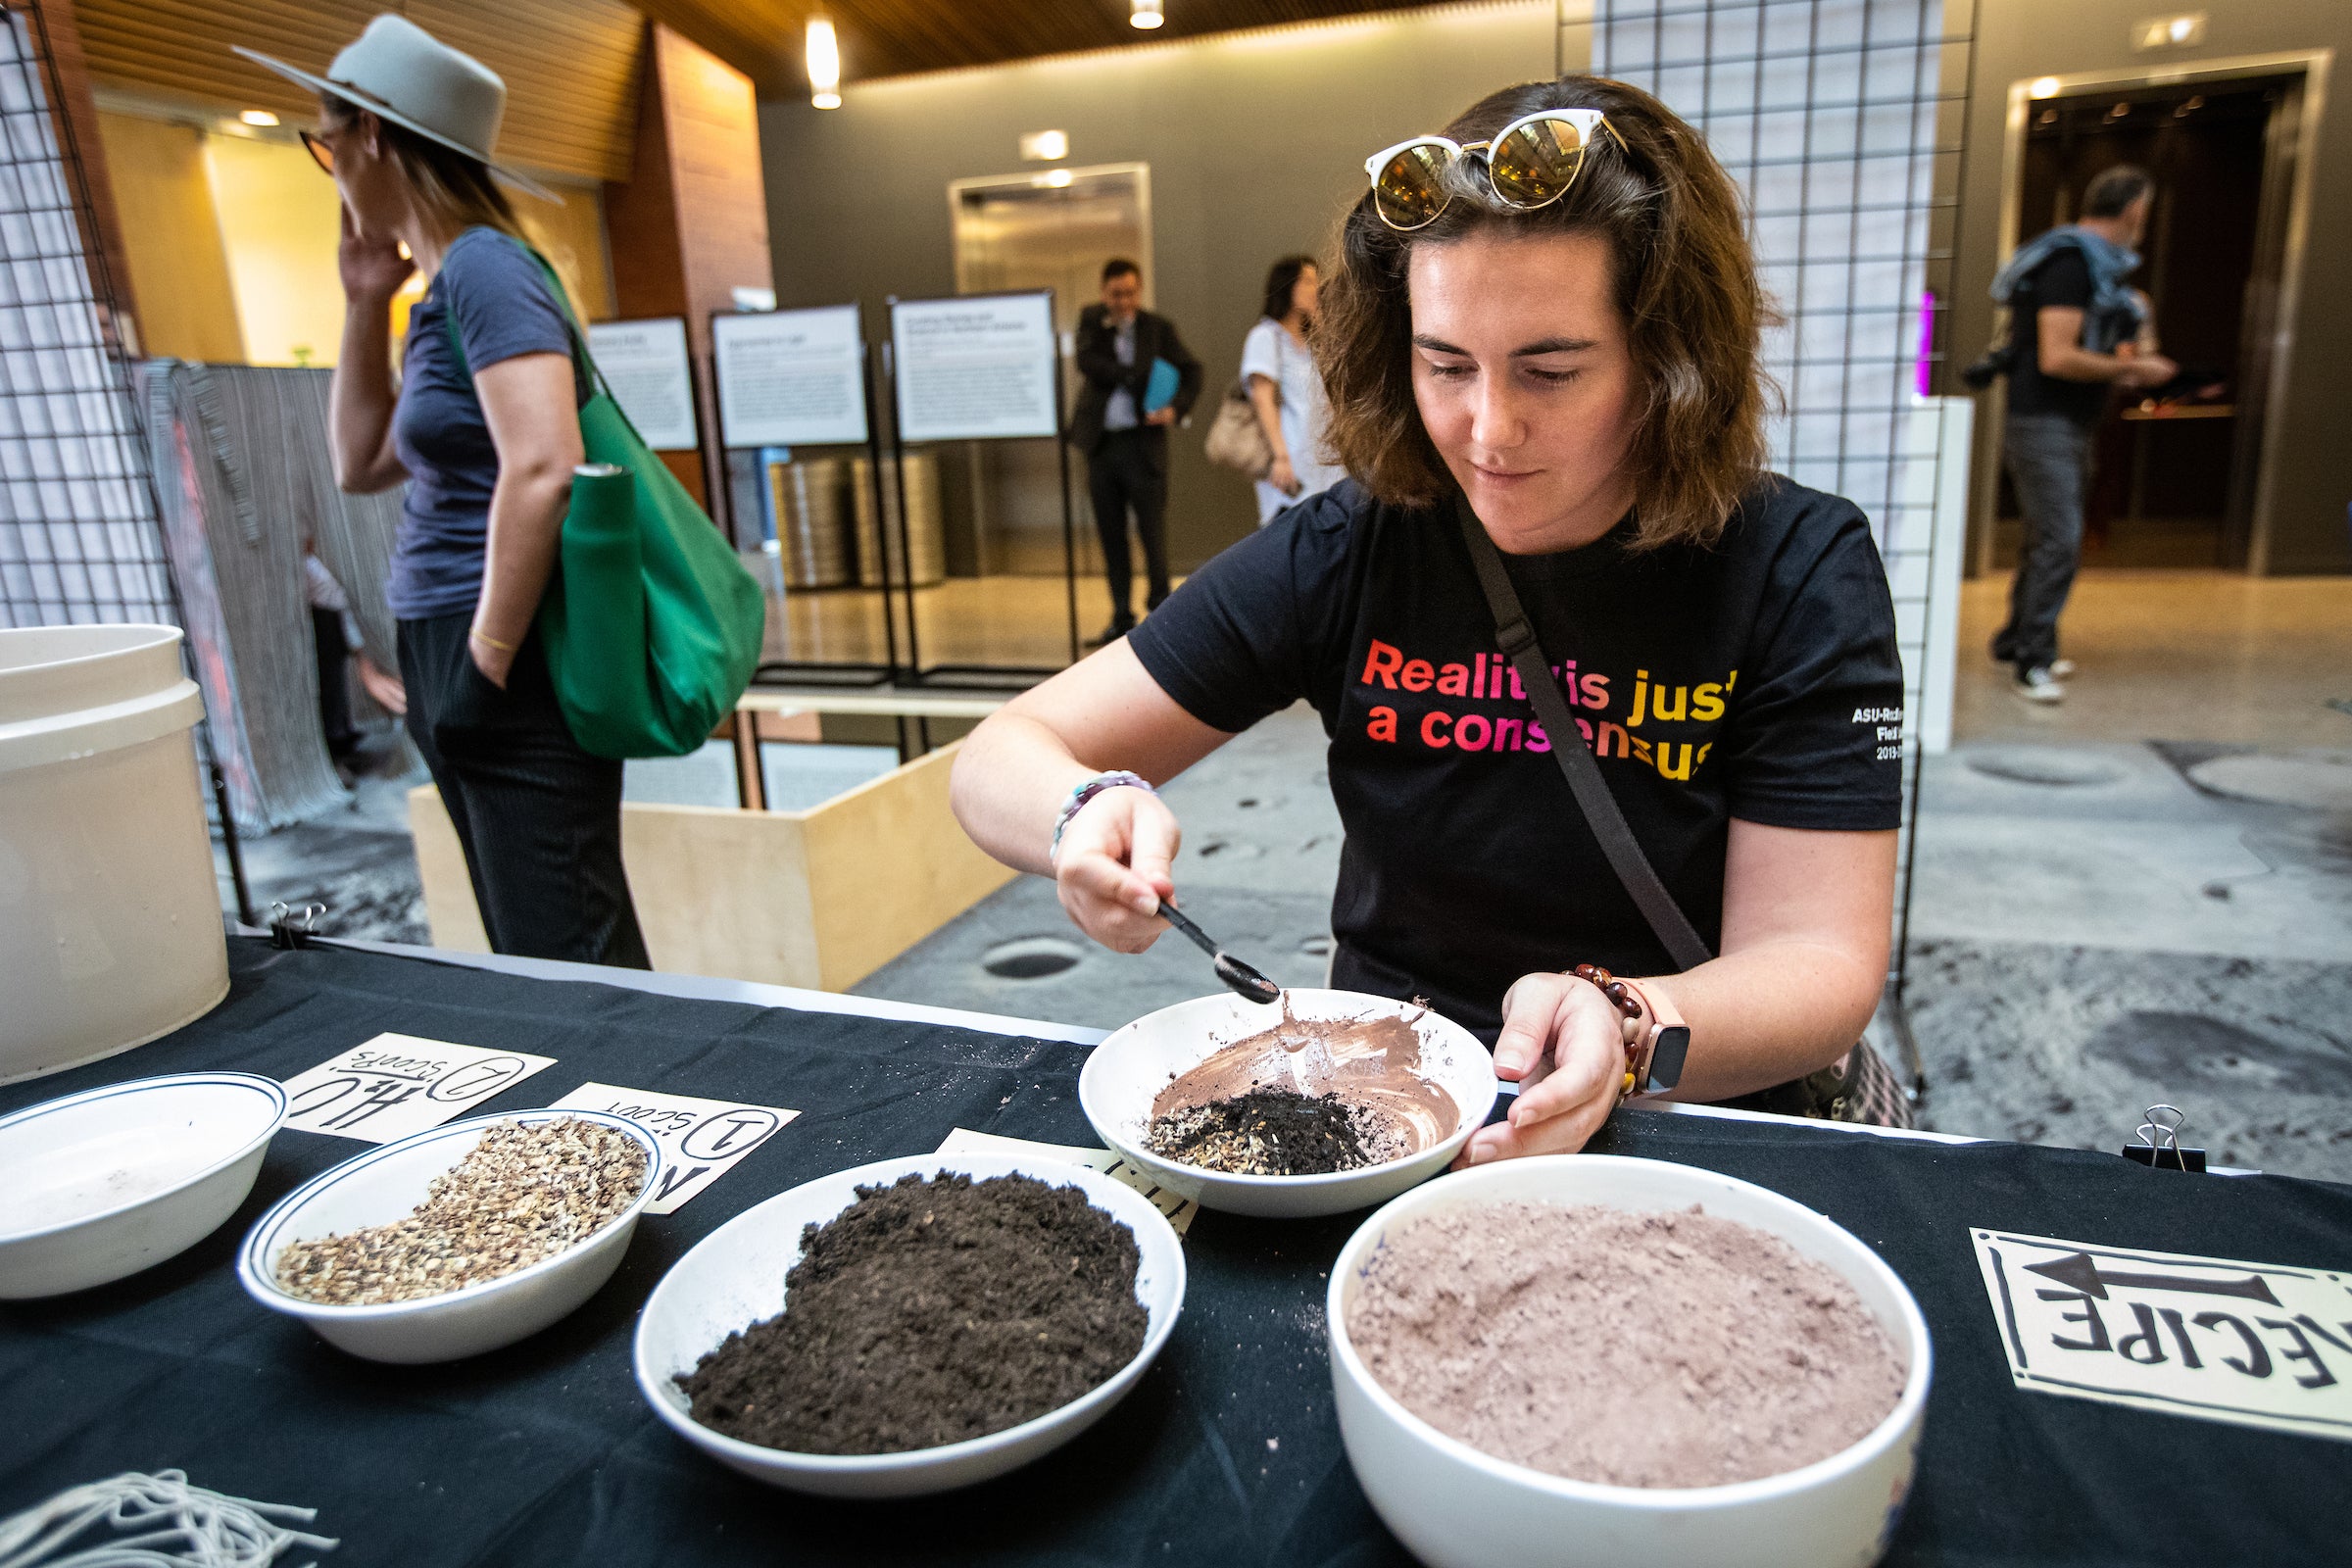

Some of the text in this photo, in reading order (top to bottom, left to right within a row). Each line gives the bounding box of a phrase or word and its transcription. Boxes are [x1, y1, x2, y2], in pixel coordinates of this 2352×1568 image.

[1566, 659, 1611, 710] is
[1366, 705, 1398, 743] a
[351, 1052, 448, 1077] SCOOPS
